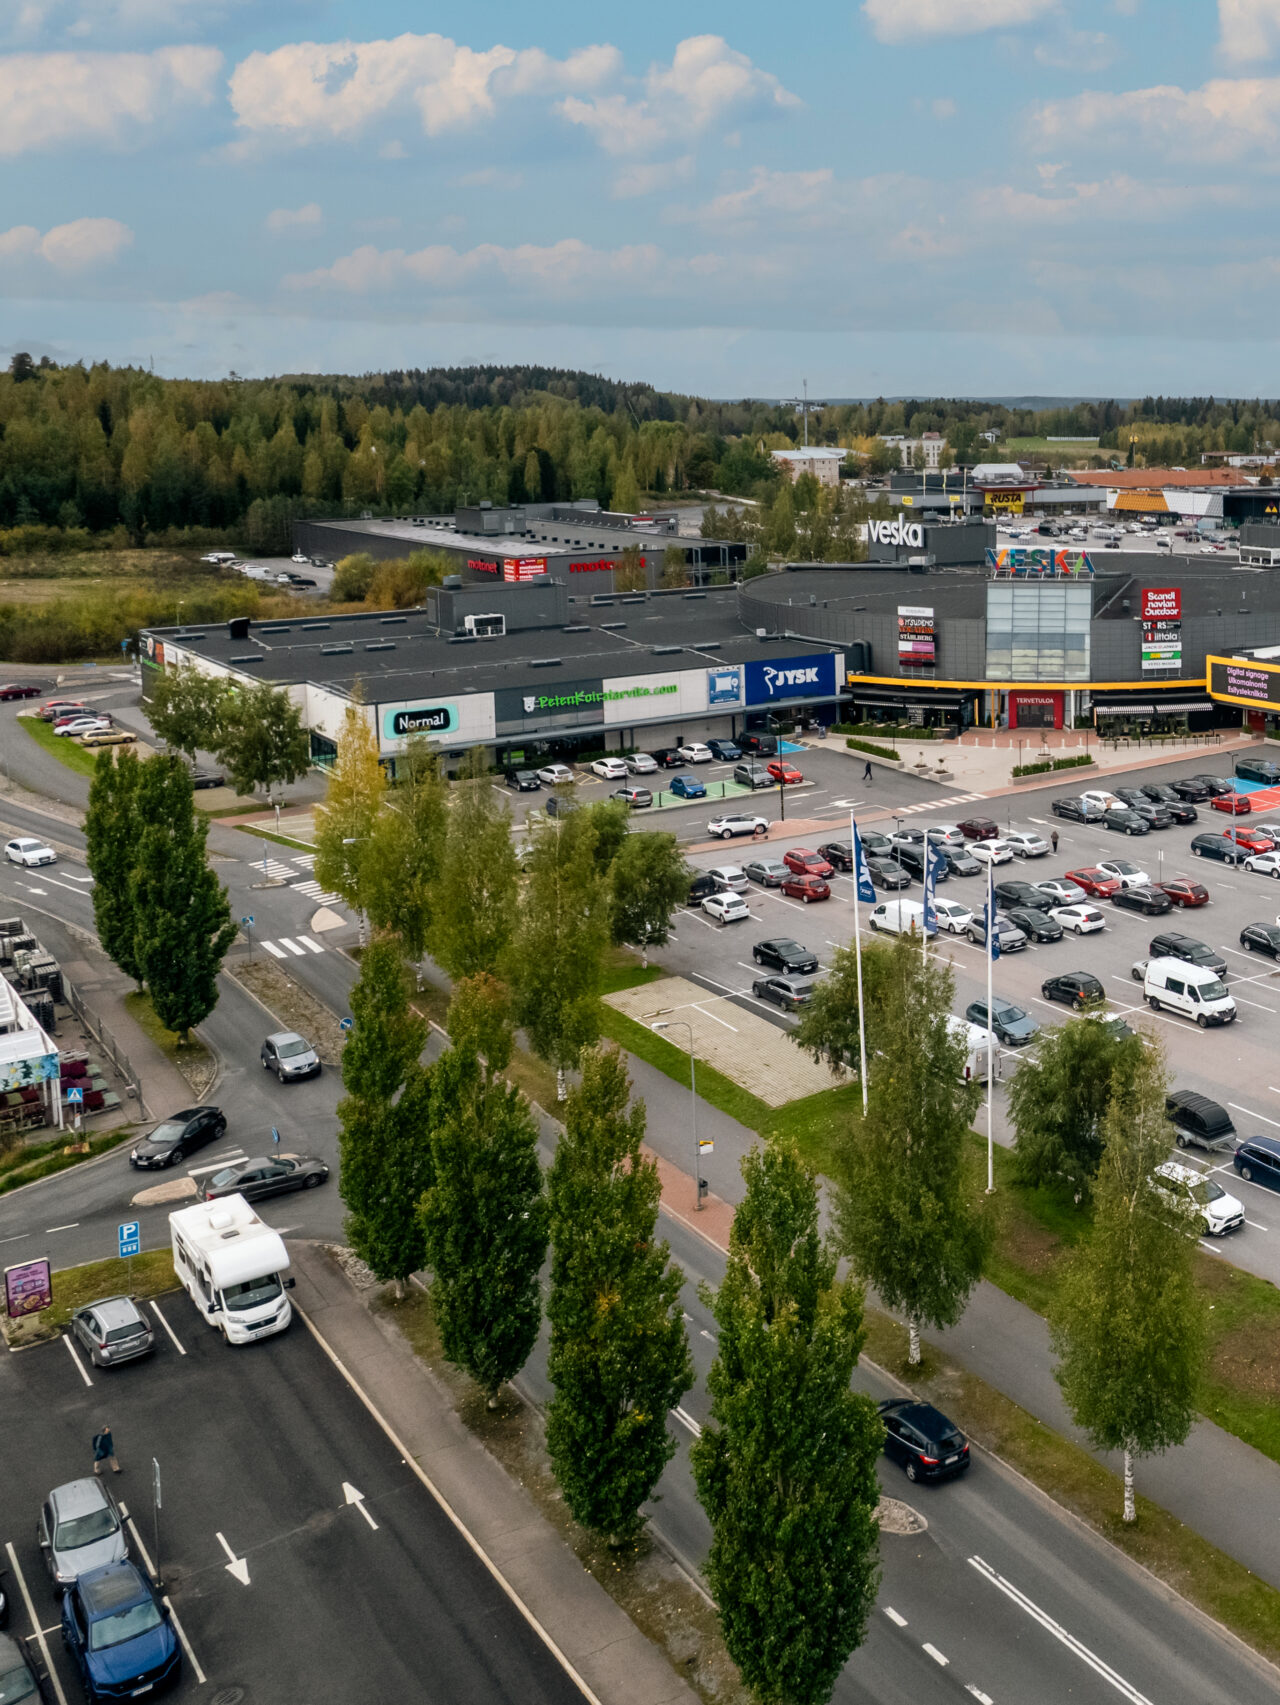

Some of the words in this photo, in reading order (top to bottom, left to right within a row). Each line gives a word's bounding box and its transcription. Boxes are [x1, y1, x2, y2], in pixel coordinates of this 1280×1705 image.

[991, 493, 1022, 503] RUSTA
[868, 513, 924, 548] veska
[467, 559, 498, 575] motonet
[569, 556, 647, 573] motot
[985, 549, 1095, 573] VESKA
[1147, 592, 1176, 600] Scandi
[1144, 608, 1179, 616] Outdoor
[1154, 632, 1178, 641] iittala
[775, 667, 820, 686] JYSK
[1226, 667, 1245, 676] Digital
[1245, 670, 1269, 681] signage
[1228, 676, 1268, 690] Ulkomainonta
[399, 712, 445, 730] Normal
[123, 1224, 136, 1240] P
